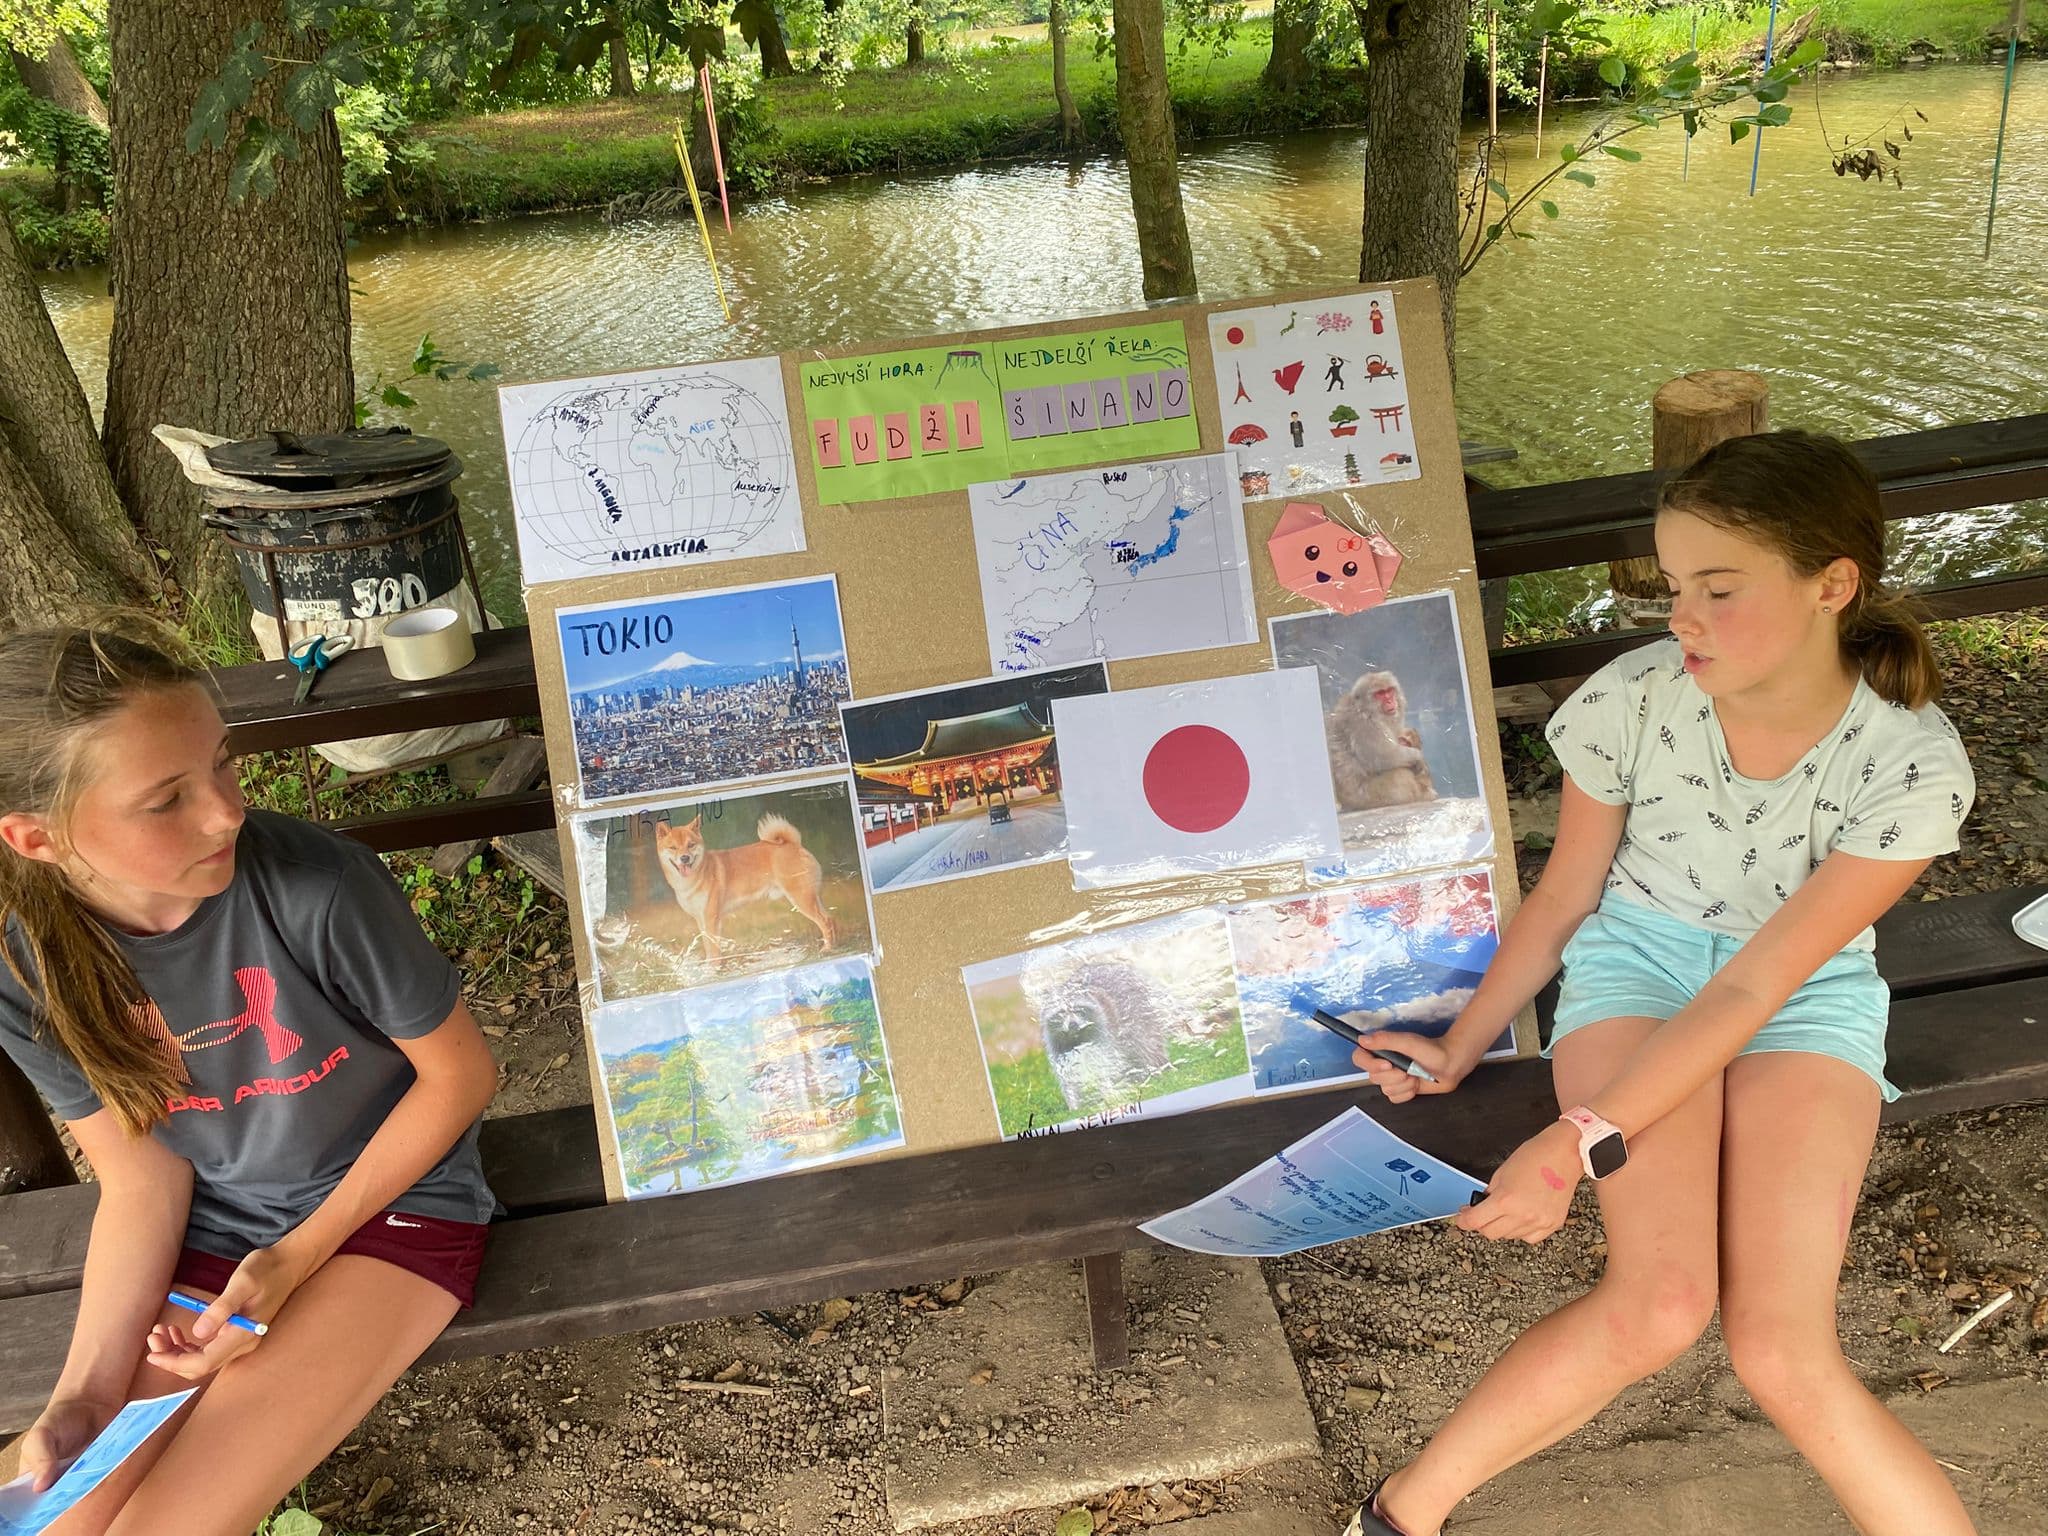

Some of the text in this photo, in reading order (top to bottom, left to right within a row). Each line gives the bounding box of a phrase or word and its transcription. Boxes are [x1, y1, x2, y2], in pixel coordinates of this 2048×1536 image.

[1003, 338, 1096, 370] NEJDELŠÍ
[808, 359, 872, 389] NEJVYŠÍ
[568, 614, 673, 656] TOKIO
[167, 1046, 350, 1113] DER ARMOUR
